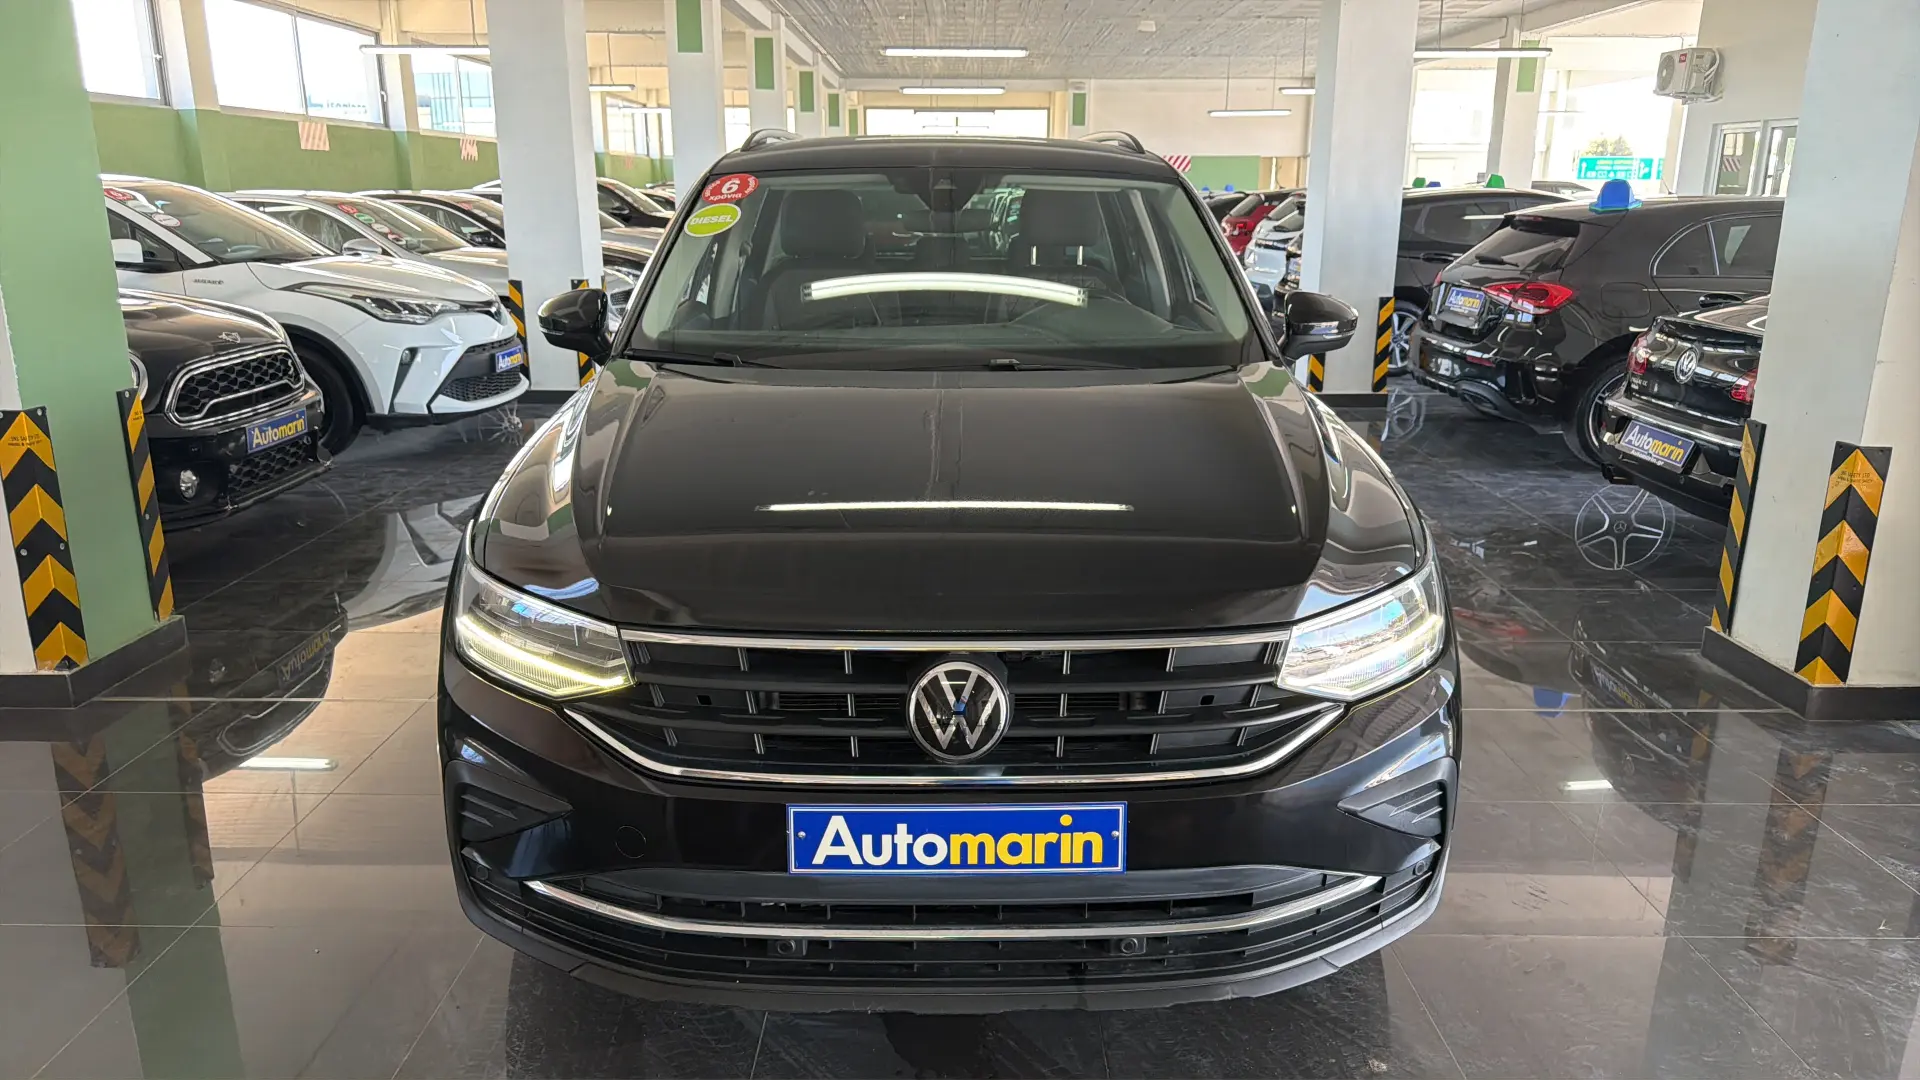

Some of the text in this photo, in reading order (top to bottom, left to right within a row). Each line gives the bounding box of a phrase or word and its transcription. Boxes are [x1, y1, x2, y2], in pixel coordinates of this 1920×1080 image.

[721, 179, 740, 194] 6
[690, 214, 733, 225] DIESEL
[252, 413, 305, 448] Automarin
[1625, 424, 1685, 462] Automarin
[812, 813, 1103, 866] Automarin
